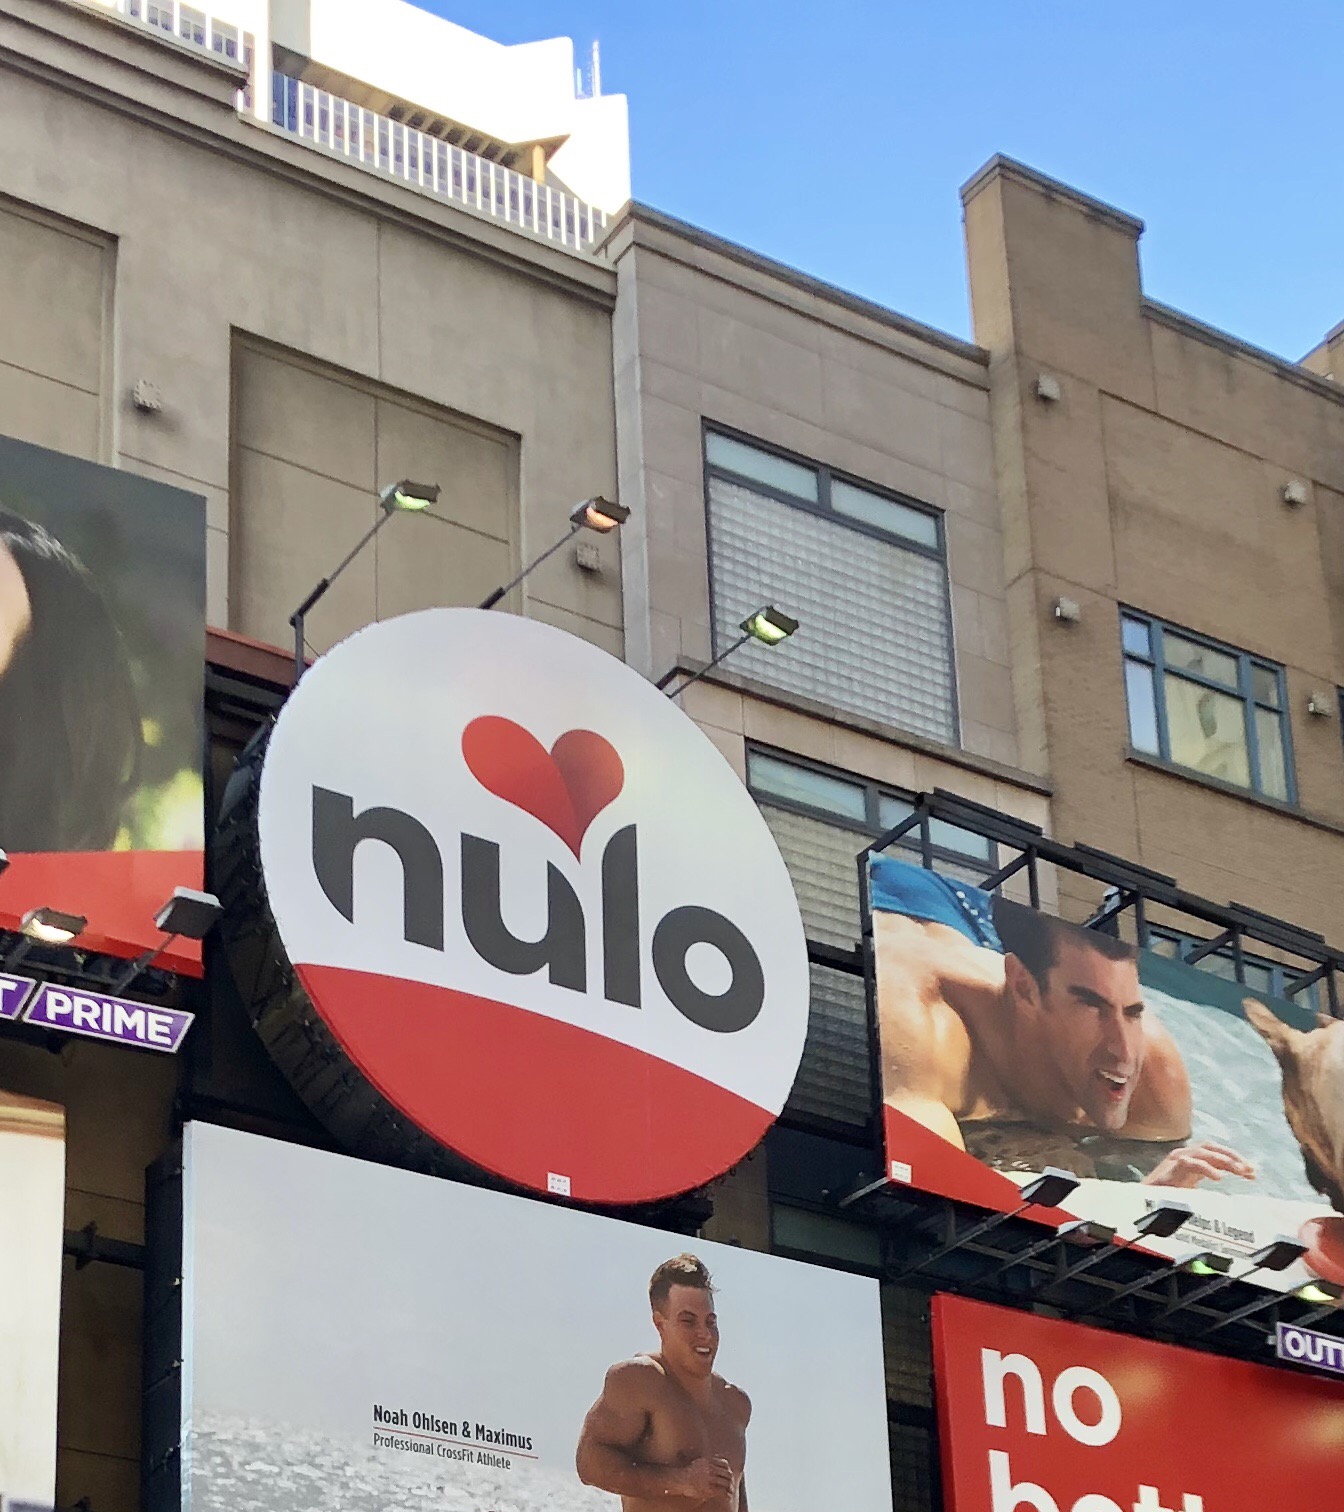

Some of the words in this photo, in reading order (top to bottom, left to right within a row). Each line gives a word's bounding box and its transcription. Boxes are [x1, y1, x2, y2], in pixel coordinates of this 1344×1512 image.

[312, 784, 765, 1033] nulo
[46, 992, 175, 1046] PRIME
[981, 1347, 1122, 1447] no
[373, 1404, 408, 1427] Noah
[412, 1412, 458, 1436] Ohlsen
[461, 1421, 472, 1438] &
[475, 1423, 533, 1451] Maximus
[373, 1433, 434, 1456] Professional
[437, 1444, 474, 1464] CrossFit
[476, 1451, 512, 1470] Athlete
